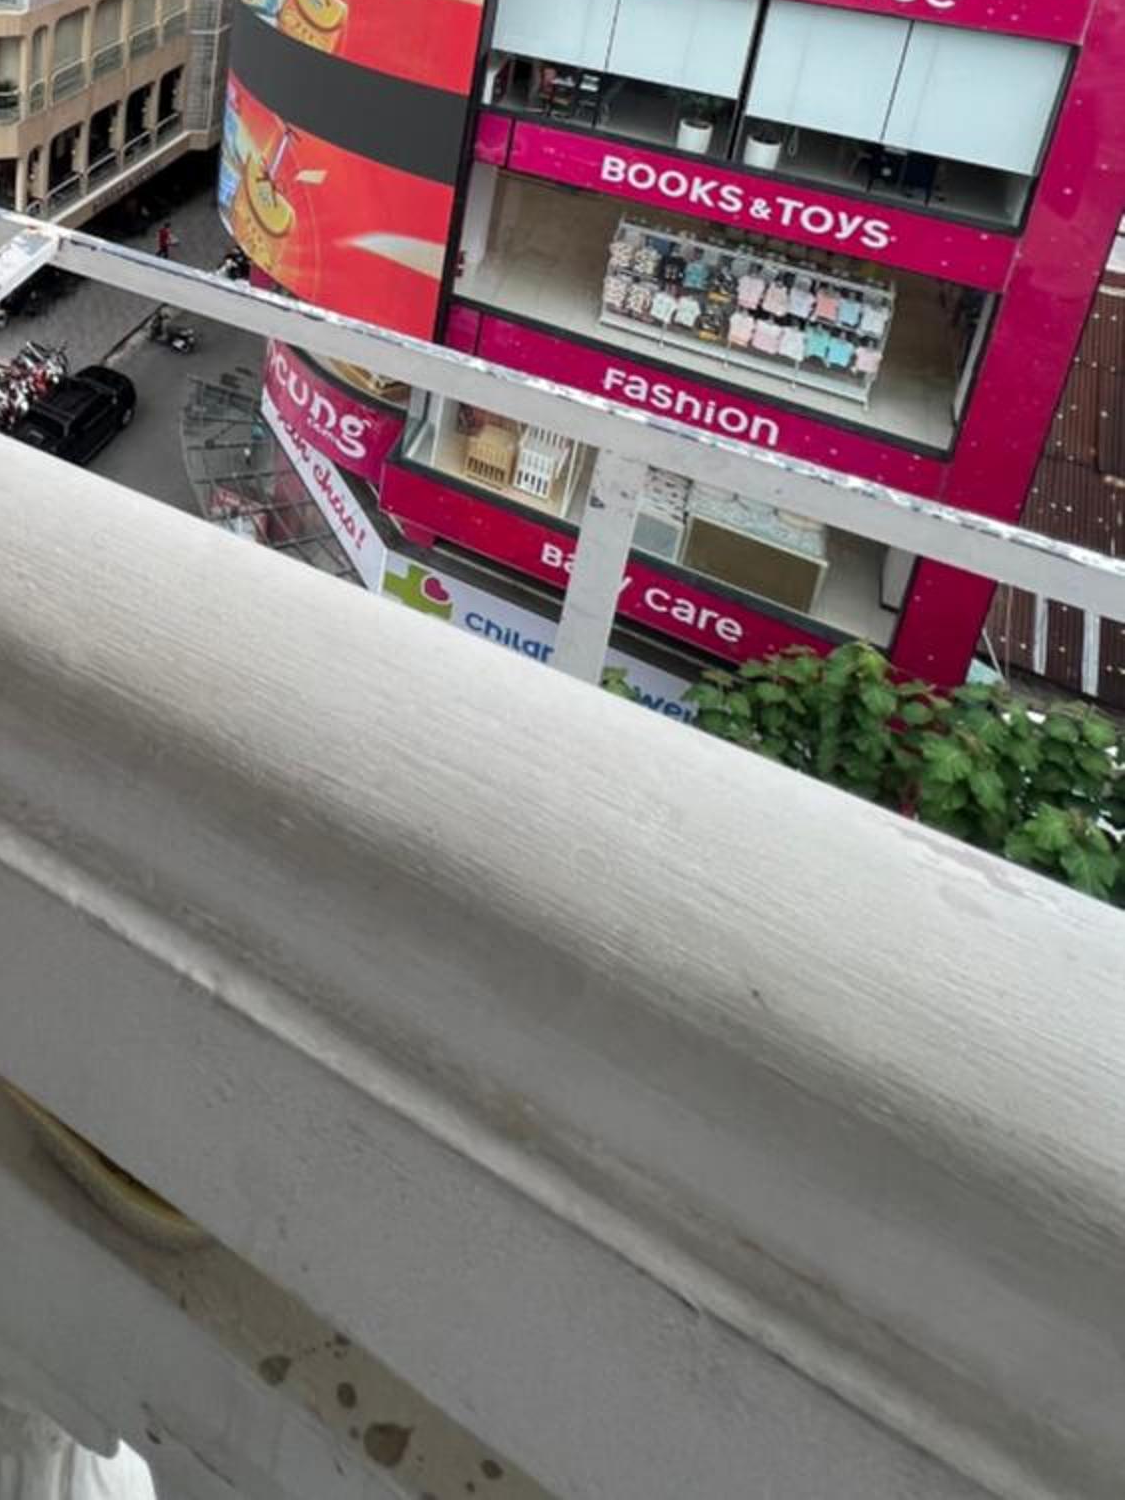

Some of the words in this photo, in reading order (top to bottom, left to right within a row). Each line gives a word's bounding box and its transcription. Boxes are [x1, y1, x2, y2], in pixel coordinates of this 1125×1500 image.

[601, 155, 744, 213] BOOKS
[603, 367, 780, 446] Fashion
[643, 587, 743, 643] care
